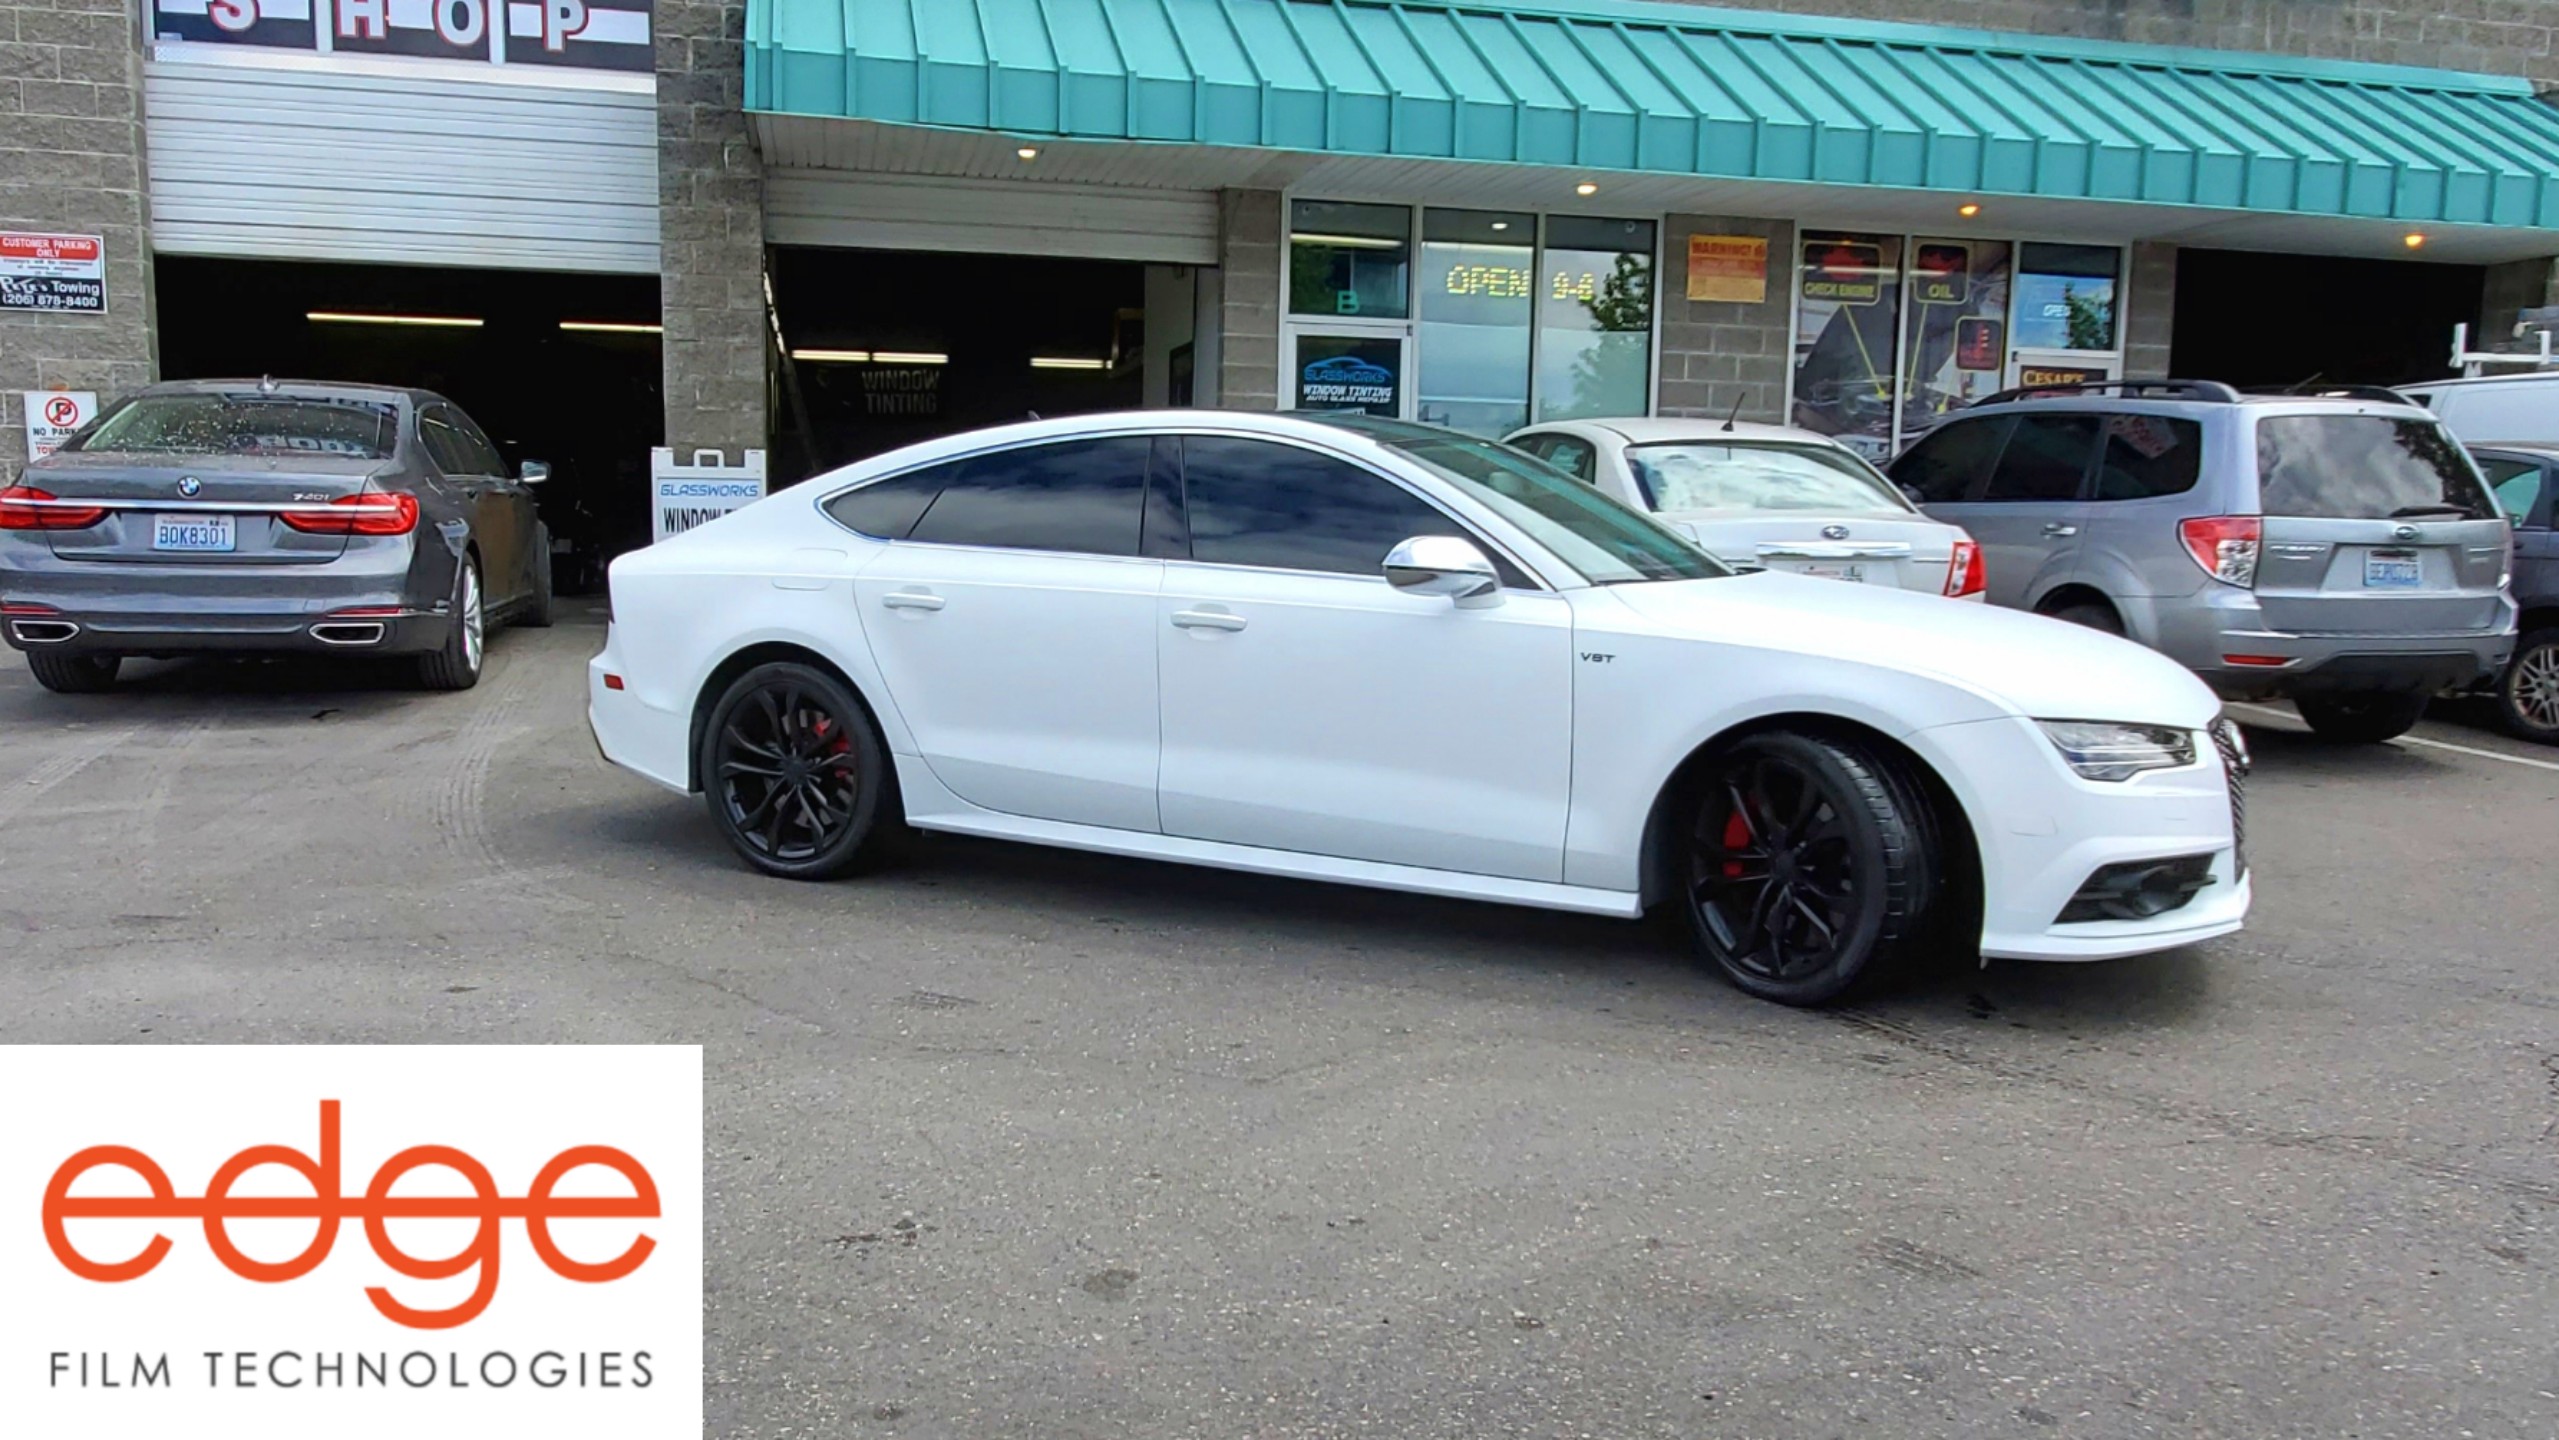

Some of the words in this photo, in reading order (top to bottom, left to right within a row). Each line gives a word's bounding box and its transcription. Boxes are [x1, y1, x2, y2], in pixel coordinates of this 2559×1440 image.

[3, 237, 49, 248] CUSTOMER
[53, 240, 92, 250] PARKING
[36, 249, 60, 257] ONLY
[1446, 265, 1531, 297] OPEN
[50, 280, 100, 297] Towing
[1804, 282, 1837, 296] CHECK
[1839, 283, 1875, 298] ENGINE
[1928, 284, 1955, 298] OIL
[2, 293, 35, 305] (206)
[38, 294, 98, 307] 878-8400
[1337, 290, 1360, 314] B
[862, 369, 939, 391] WINDOW
[1304, 368, 1386, 383] GLASSWORKS
[1303, 384, 1347, 396] WINDOW
[1349, 385, 1393, 398] TINTING
[865, 392, 937, 414] TINTING
[1330, 395, 1356, 403] GLASS
[33, 427, 46, 436] NO
[52, 427, 78, 436] PARK
[660, 484, 758, 497] GLASSWORKS
